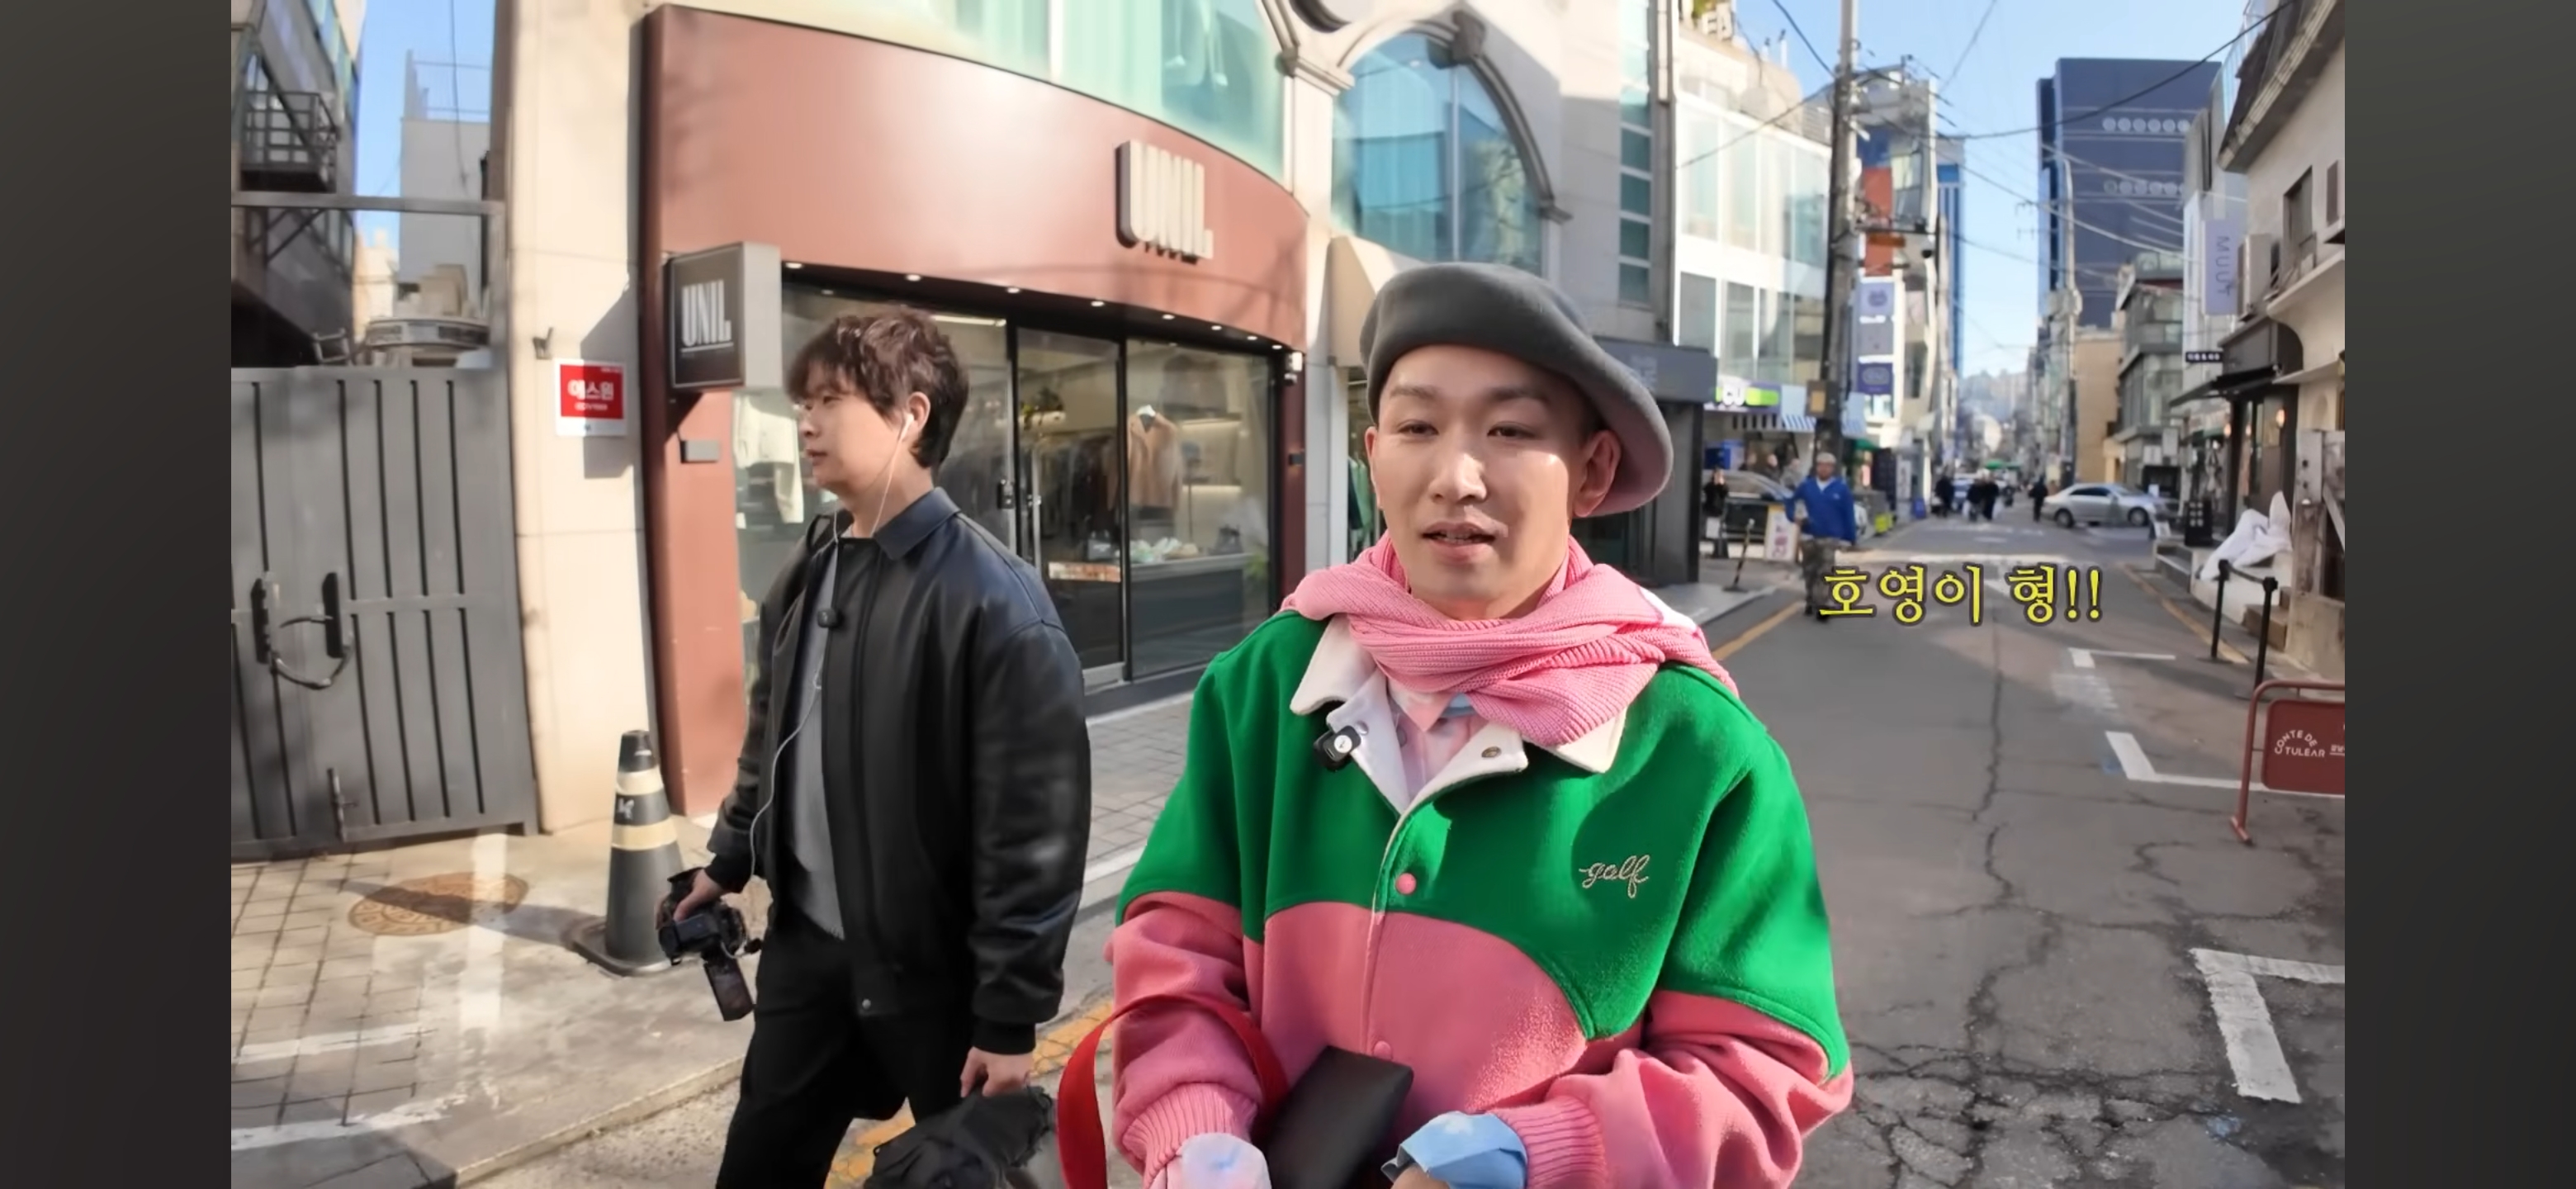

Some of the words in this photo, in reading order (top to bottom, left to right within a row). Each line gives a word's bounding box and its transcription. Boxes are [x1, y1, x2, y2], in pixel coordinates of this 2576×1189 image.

[1118, 140, 1214, 259] UNIL
[682, 279, 732, 347] UNIL
[567, 379, 614, 400] 에스원
[2275, 730, 2304, 755] CONTE
[2304, 733, 2318, 747] DE
[2285, 746, 2326, 758] TULEAR
